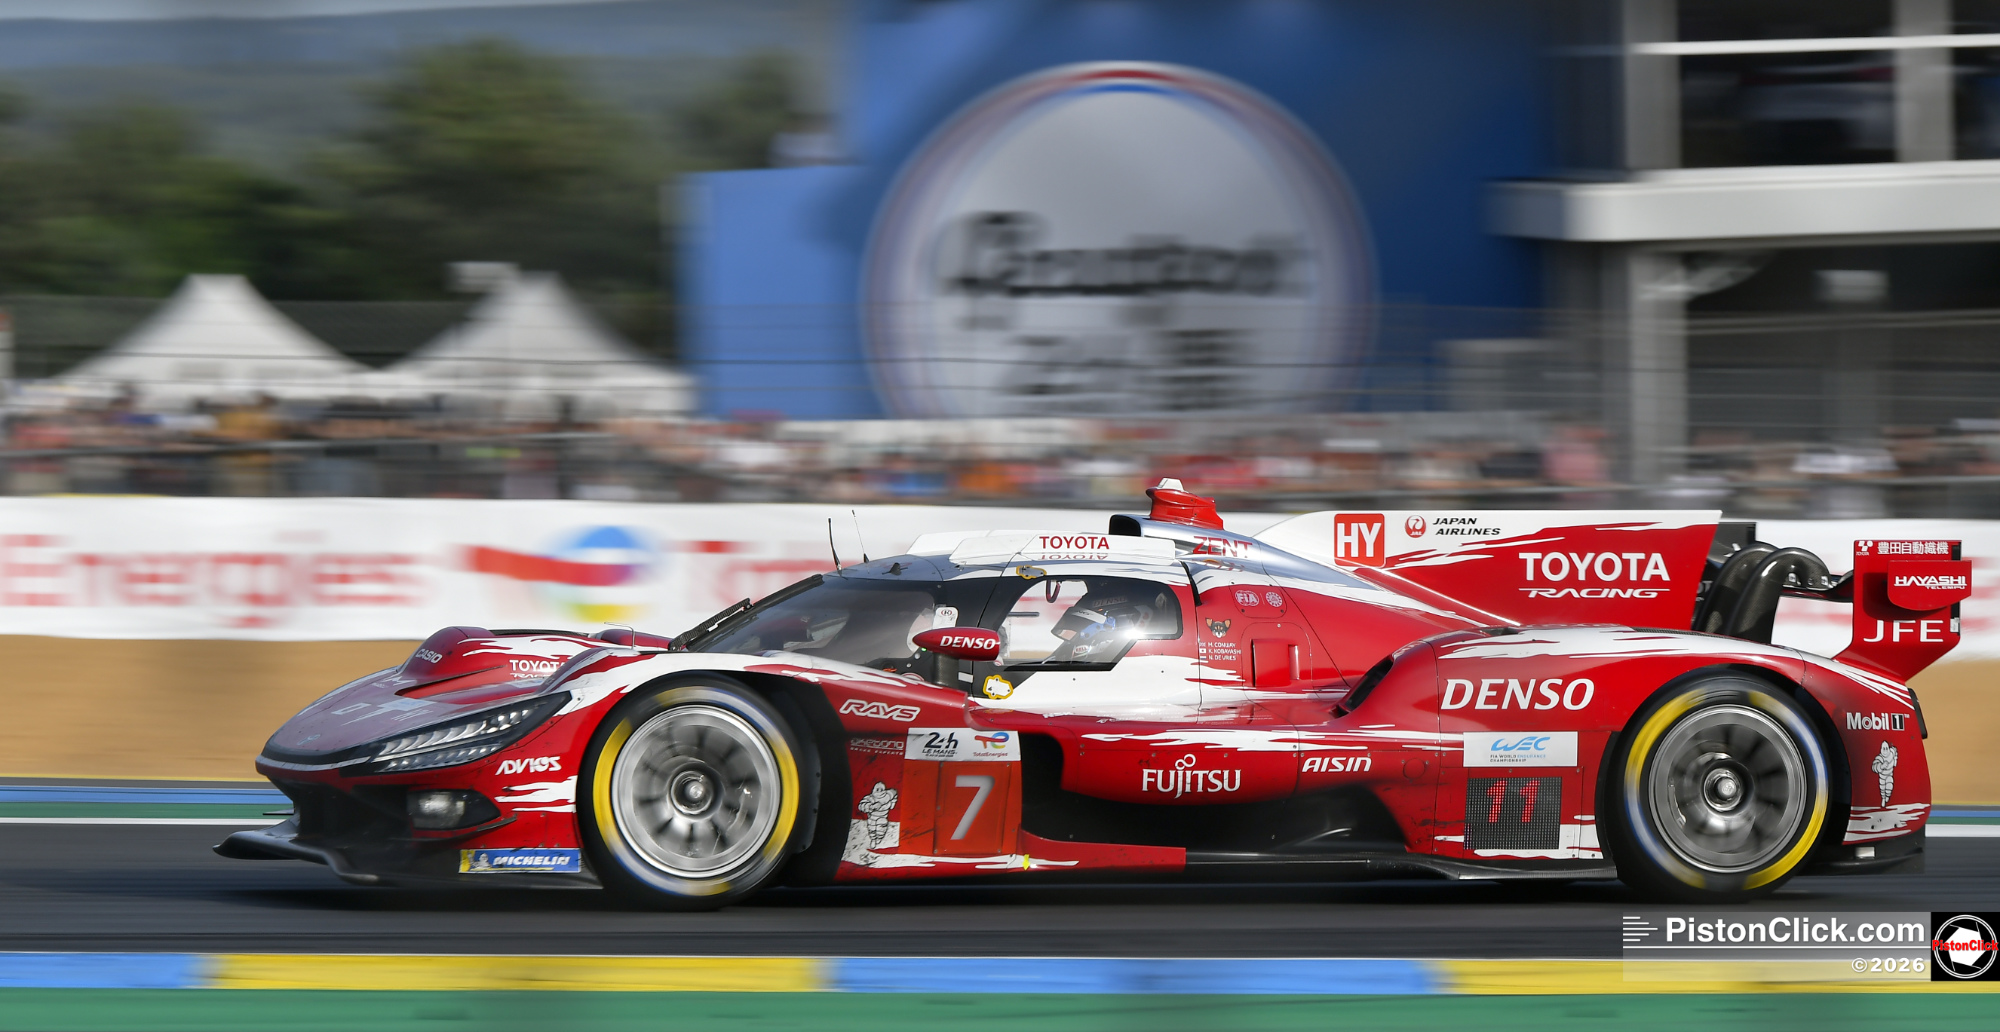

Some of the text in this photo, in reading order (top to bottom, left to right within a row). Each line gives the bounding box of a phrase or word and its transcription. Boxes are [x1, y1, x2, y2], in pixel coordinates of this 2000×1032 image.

[1433, 517, 1478, 526] JAPAN
[1337, 521, 1382, 559] HY
[1435, 527, 1501, 536] AIRLINES
[1039, 536, 1110, 550] TOYOTA
[1192, 536, 1253, 559] ZENT
[1877, 541, 1949, 555] 豊田自動織機
[1519, 552, 1671, 582] TOYOTA
[1894, 575, 1967, 586] HAYASHI
[1236, 592, 1258, 604] FIA
[1518, 588, 1671, 599] RACING
[1863, 619, 1944, 643] JFE
[939, 636, 996, 650] DENSO
[415, 648, 443, 664] CASIO
[1440, 678, 1595, 711] DENSO
[840, 699, 921, 722] RAYS
[1846, 712, 1890, 731] Mobil
[924, 732, 959, 749] 24h
[1490, 736, 1551, 751] WEC
[495, 756, 562, 776] ADVICS
[1302, 756, 1372, 774] AISIN
[1141, 766, 1242, 799] FUJITSU
[950, 775, 996, 841] 7
[1487, 780, 1541, 823] 11
[493, 855, 571, 866] MICHELIN
